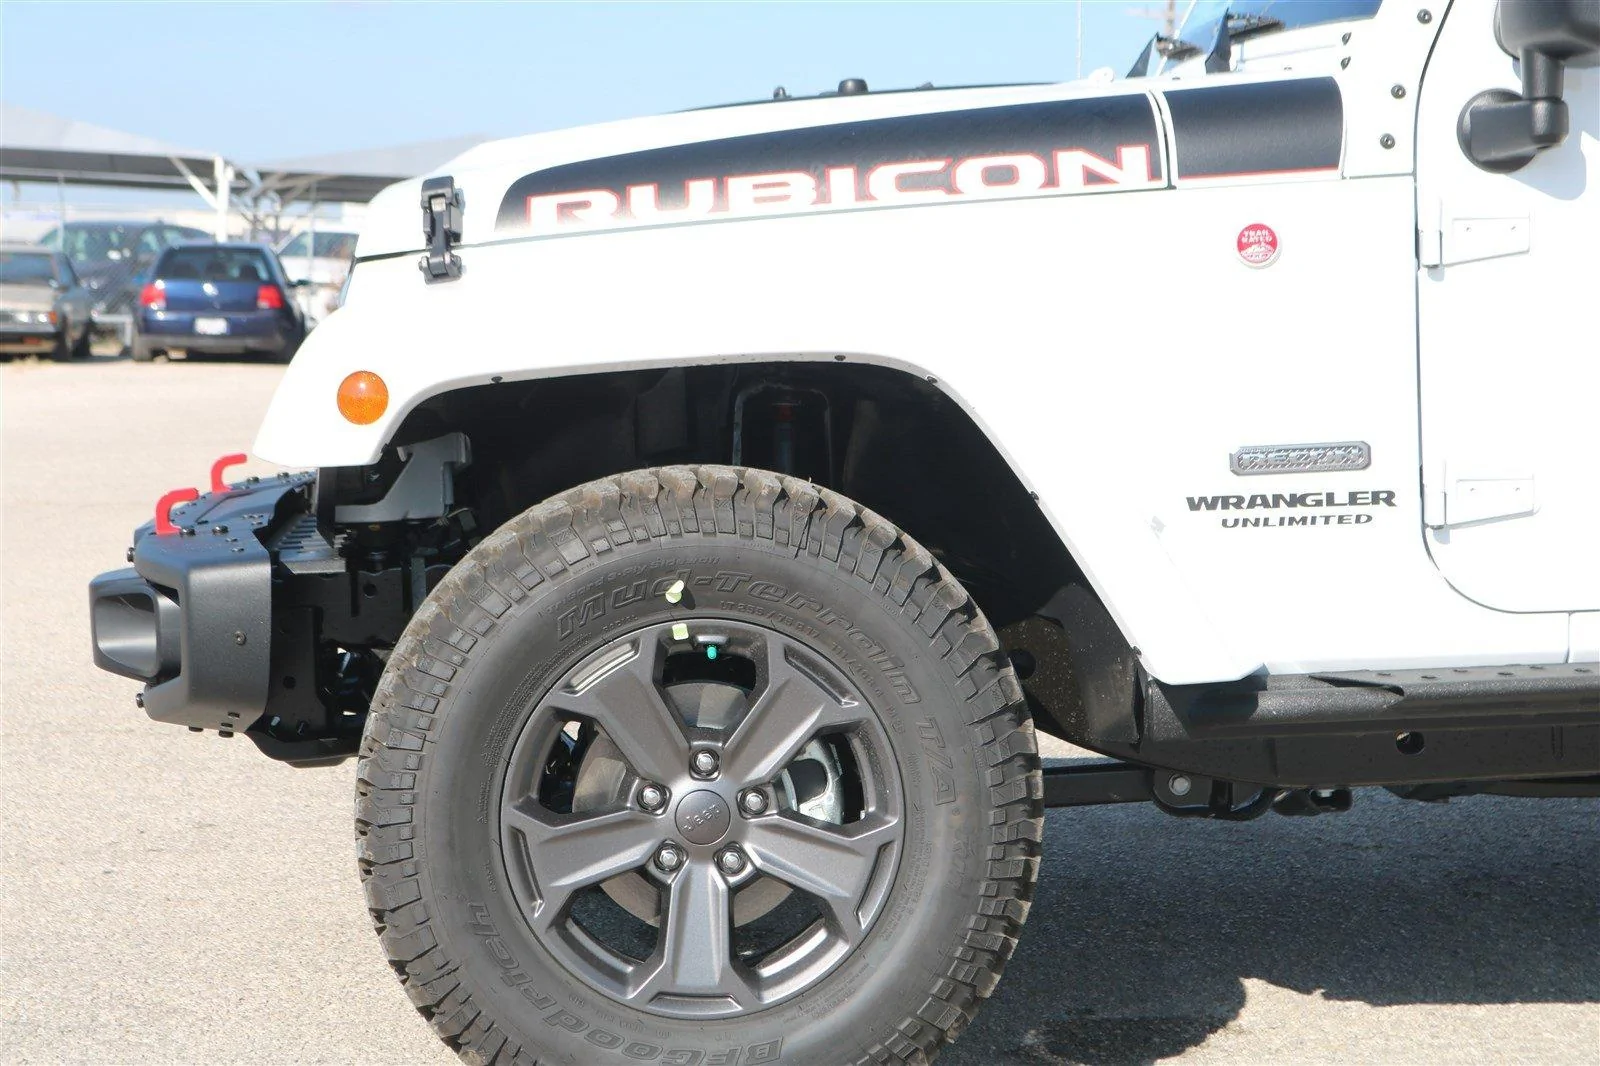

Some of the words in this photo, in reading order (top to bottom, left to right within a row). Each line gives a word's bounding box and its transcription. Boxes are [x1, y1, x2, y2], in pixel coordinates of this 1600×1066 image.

[526, 143, 1152, 227] RUBICON
[1186, 490, 1397, 511] WRANGLER
[1221, 514, 1373, 528] UNLIMITED
[680, 802, 721, 832] Jeep
[464, 900, 785, 1066] BFGoodrich
